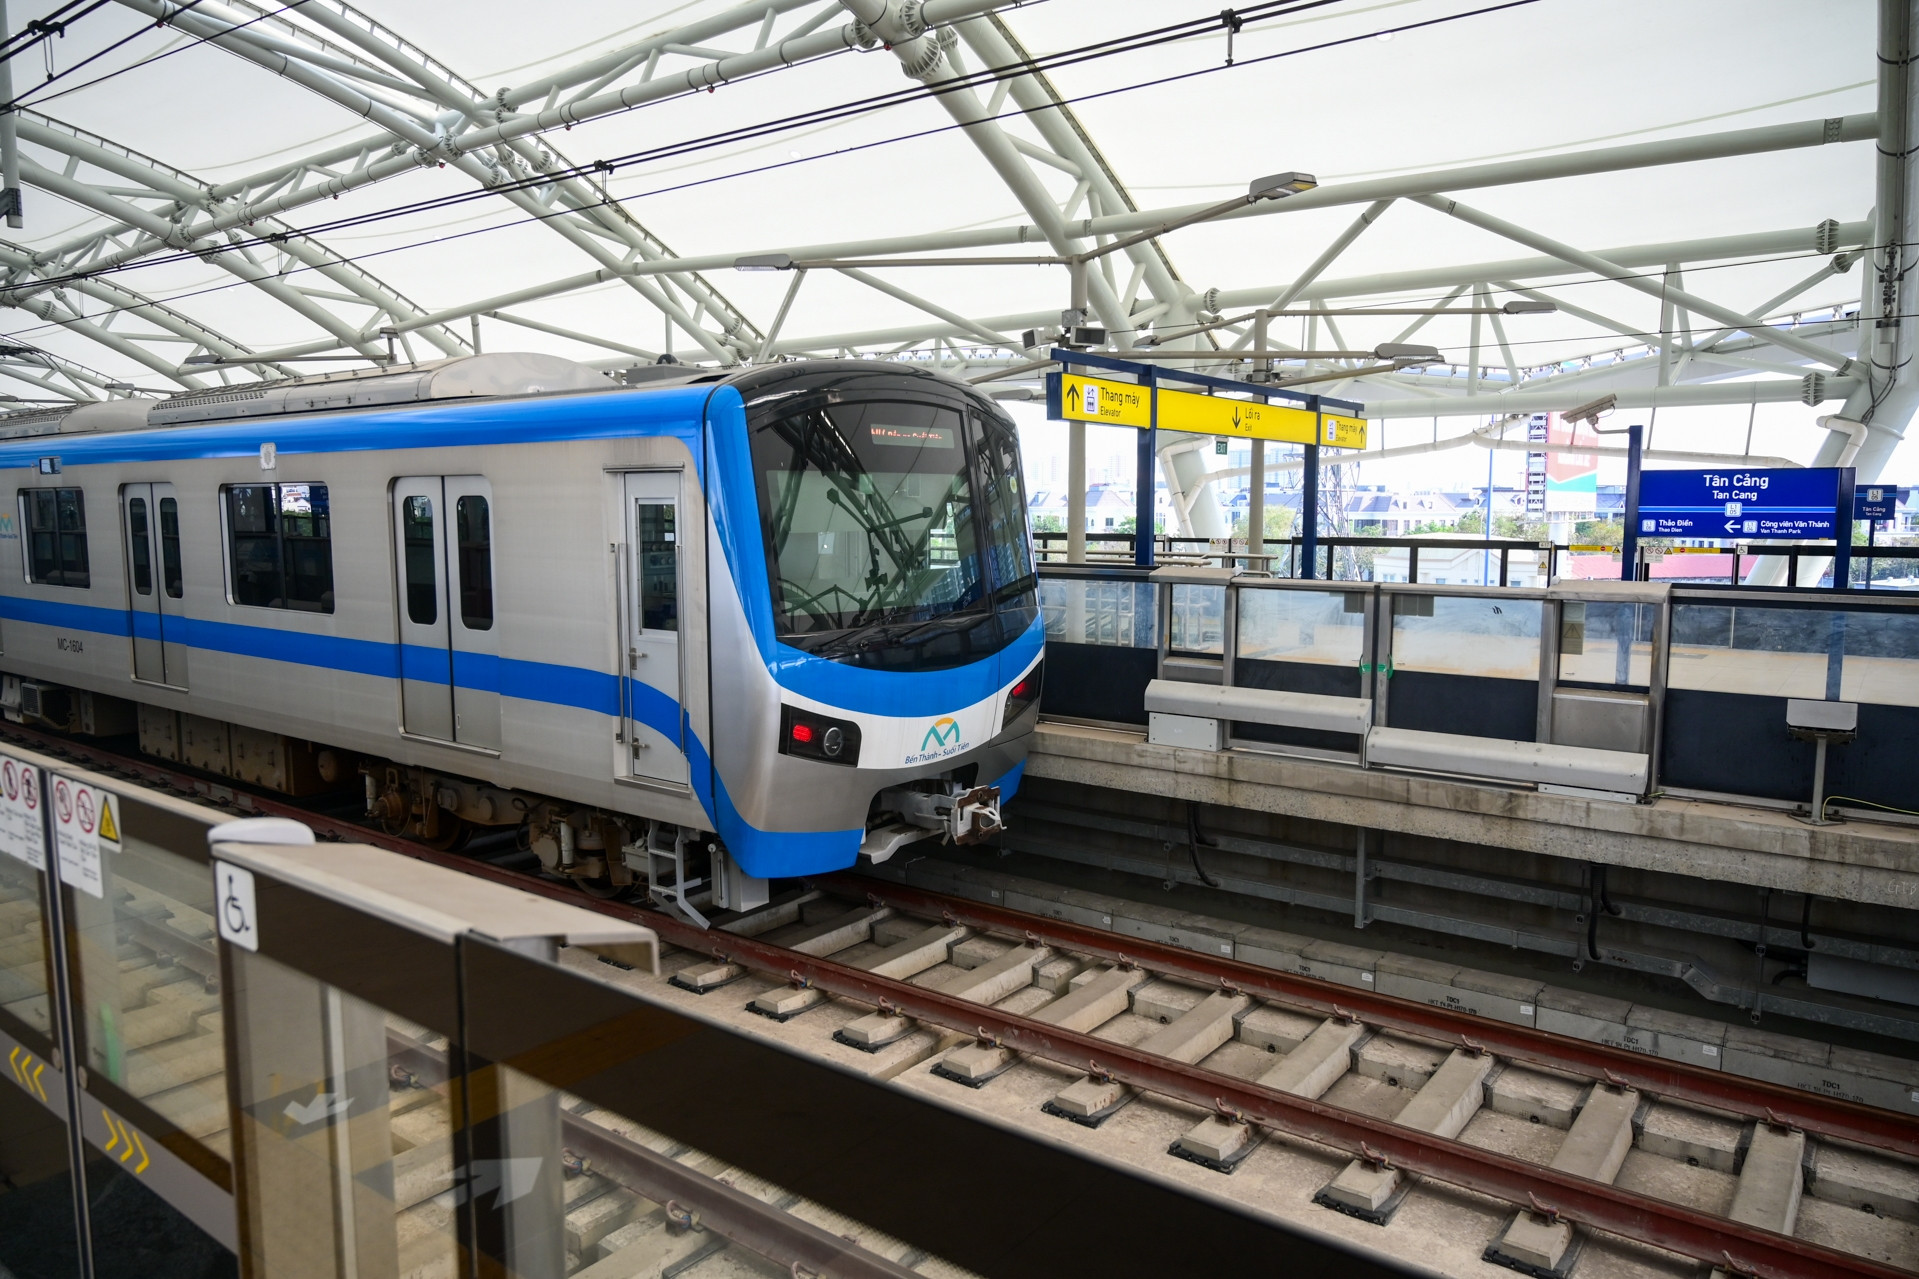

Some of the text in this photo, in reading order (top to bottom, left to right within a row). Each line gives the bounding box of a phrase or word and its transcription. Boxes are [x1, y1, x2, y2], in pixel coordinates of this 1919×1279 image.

[1100, 387, 1140, 408] Thang máy
[1100, 405, 1121, 418] Elevator
[1254, 411, 1261, 421] ra
[1245, 423, 1253, 432] Exit
[1336, 420, 1349, 435] Thang
[1217, 442, 1227, 454] EXIT
[1703, 473, 1769, 490] Tân Cảng
[1712, 490, 1758, 502] Tan Cang
[1658, 519, 1676, 527] Thảo
[1760, 520, 1778, 529] Công
[1779, 520, 1793, 528] viên
[1808, 520, 1830, 528] Thánh
[57, 637, 83, 654] MC-1604
[904, 753, 918, 765] Bến
[942, 743, 957, 757] Suối
[957, 741, 970, 752] Tiên
[1446, 995, 1460, 1004] TDC1
[1623, 1035, 1639, 1045] TDC1
[1822, 1079, 1840, 1090] TDC1
